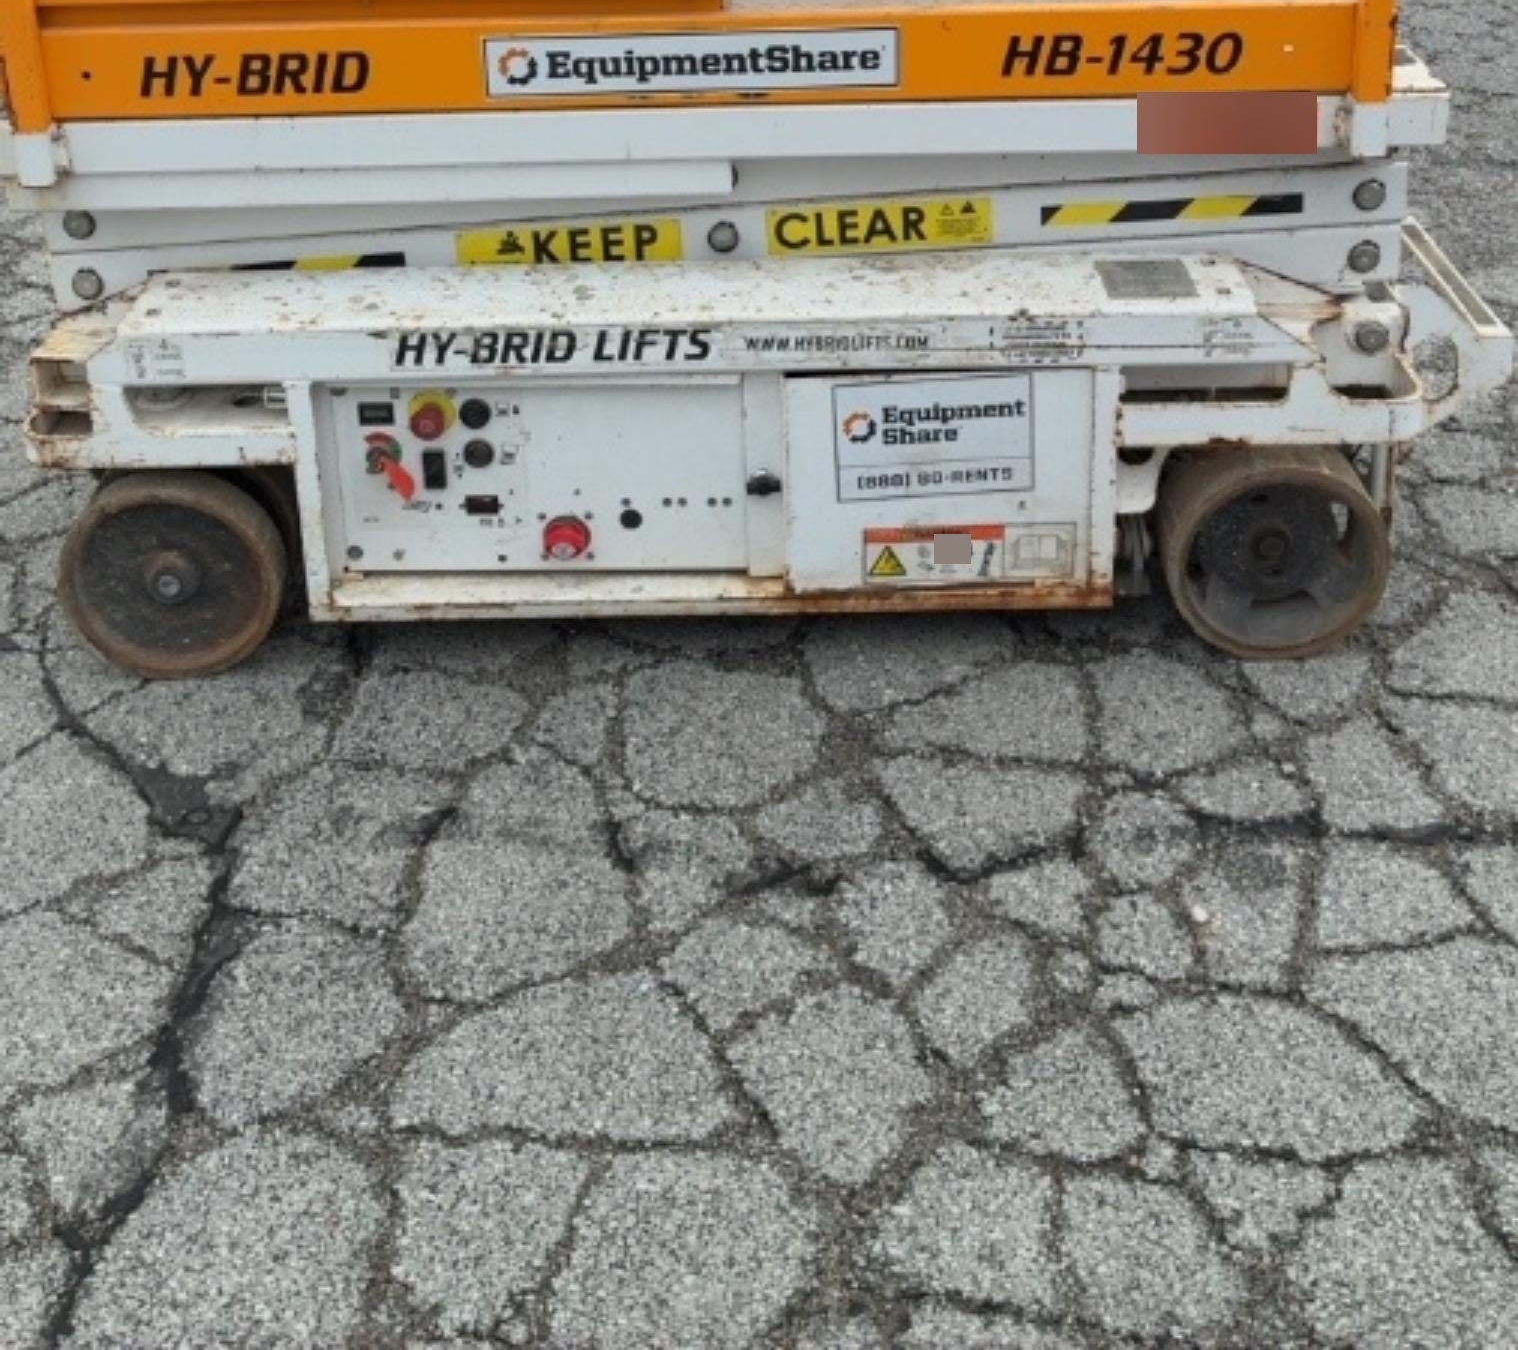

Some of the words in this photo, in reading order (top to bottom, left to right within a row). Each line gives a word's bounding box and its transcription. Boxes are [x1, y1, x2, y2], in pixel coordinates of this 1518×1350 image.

[140, 50, 370, 97] HY-BRID
[545, 44, 882, 85] EquipmentShare
[1001, 31, 1243, 77] HB-1430
[532, 224, 658, 264] KEEP
[774, 206, 928, 250] CLEAR
[394, 329, 577, 366] HY-BRID
[593, 328, 713, 361] LIFTS
[881, 398, 1026, 426] Equipment
[881, 426, 959, 445] Share
